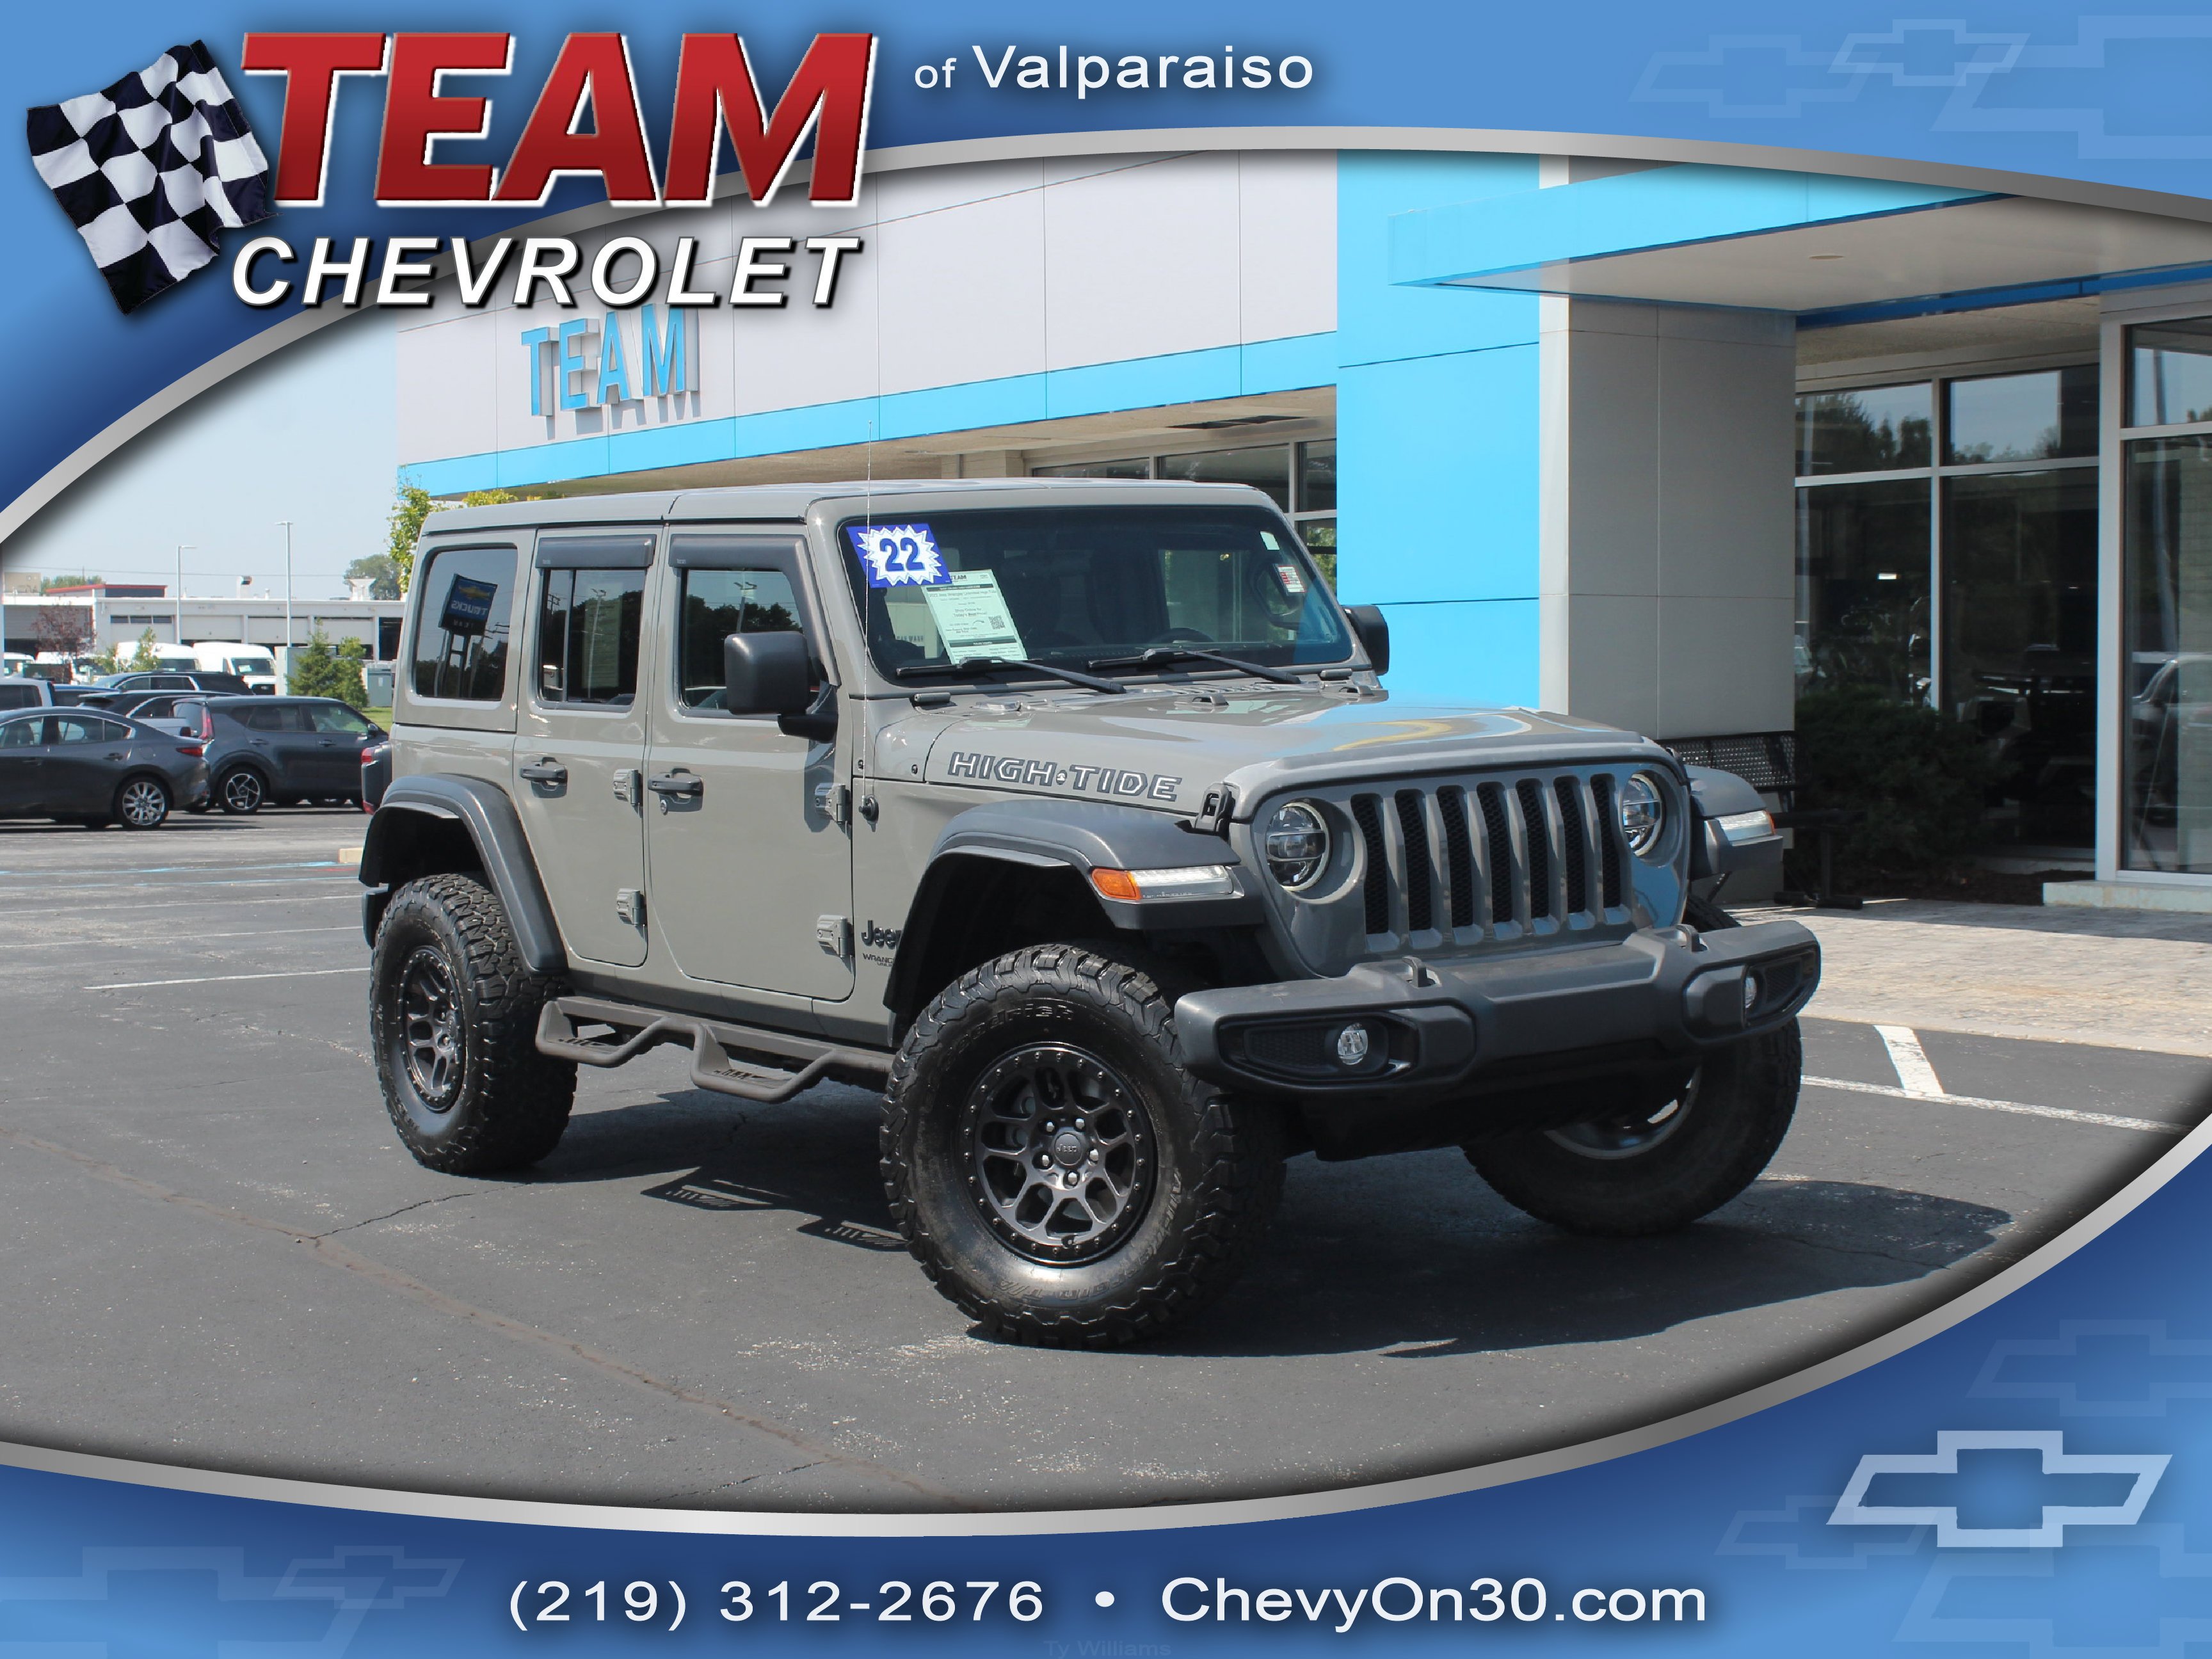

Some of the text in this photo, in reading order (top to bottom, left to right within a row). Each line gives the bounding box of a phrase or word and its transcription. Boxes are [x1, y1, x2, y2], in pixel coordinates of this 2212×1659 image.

[521, 303, 693, 417] TEAM
[879, 536, 926, 572] 22
[947, 751, 1182, 803] HIGH TIDE
